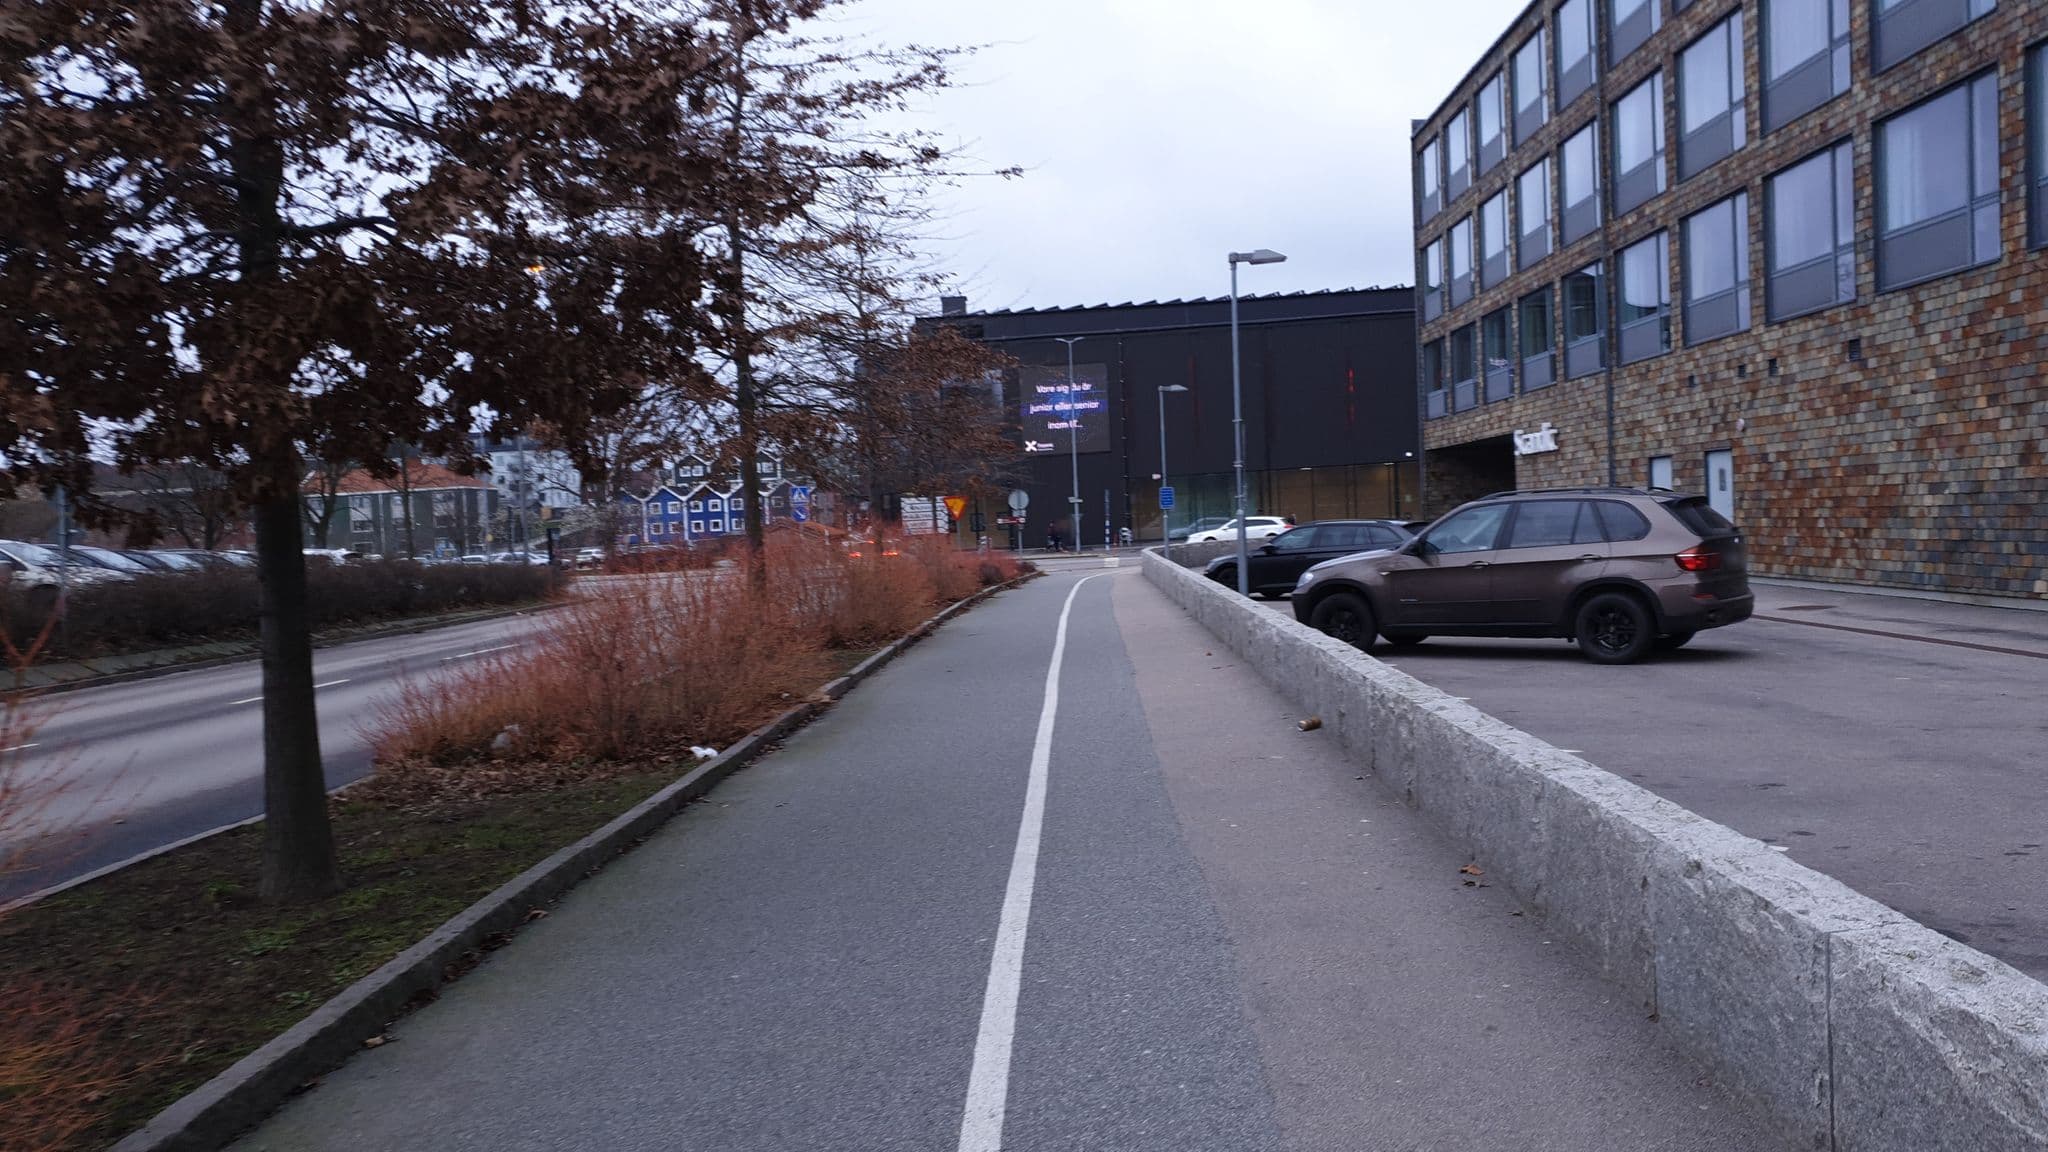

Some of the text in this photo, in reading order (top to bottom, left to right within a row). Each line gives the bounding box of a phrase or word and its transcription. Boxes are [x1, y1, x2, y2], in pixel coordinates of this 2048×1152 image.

[1029, 401, 1099, 414] junior eller senior
